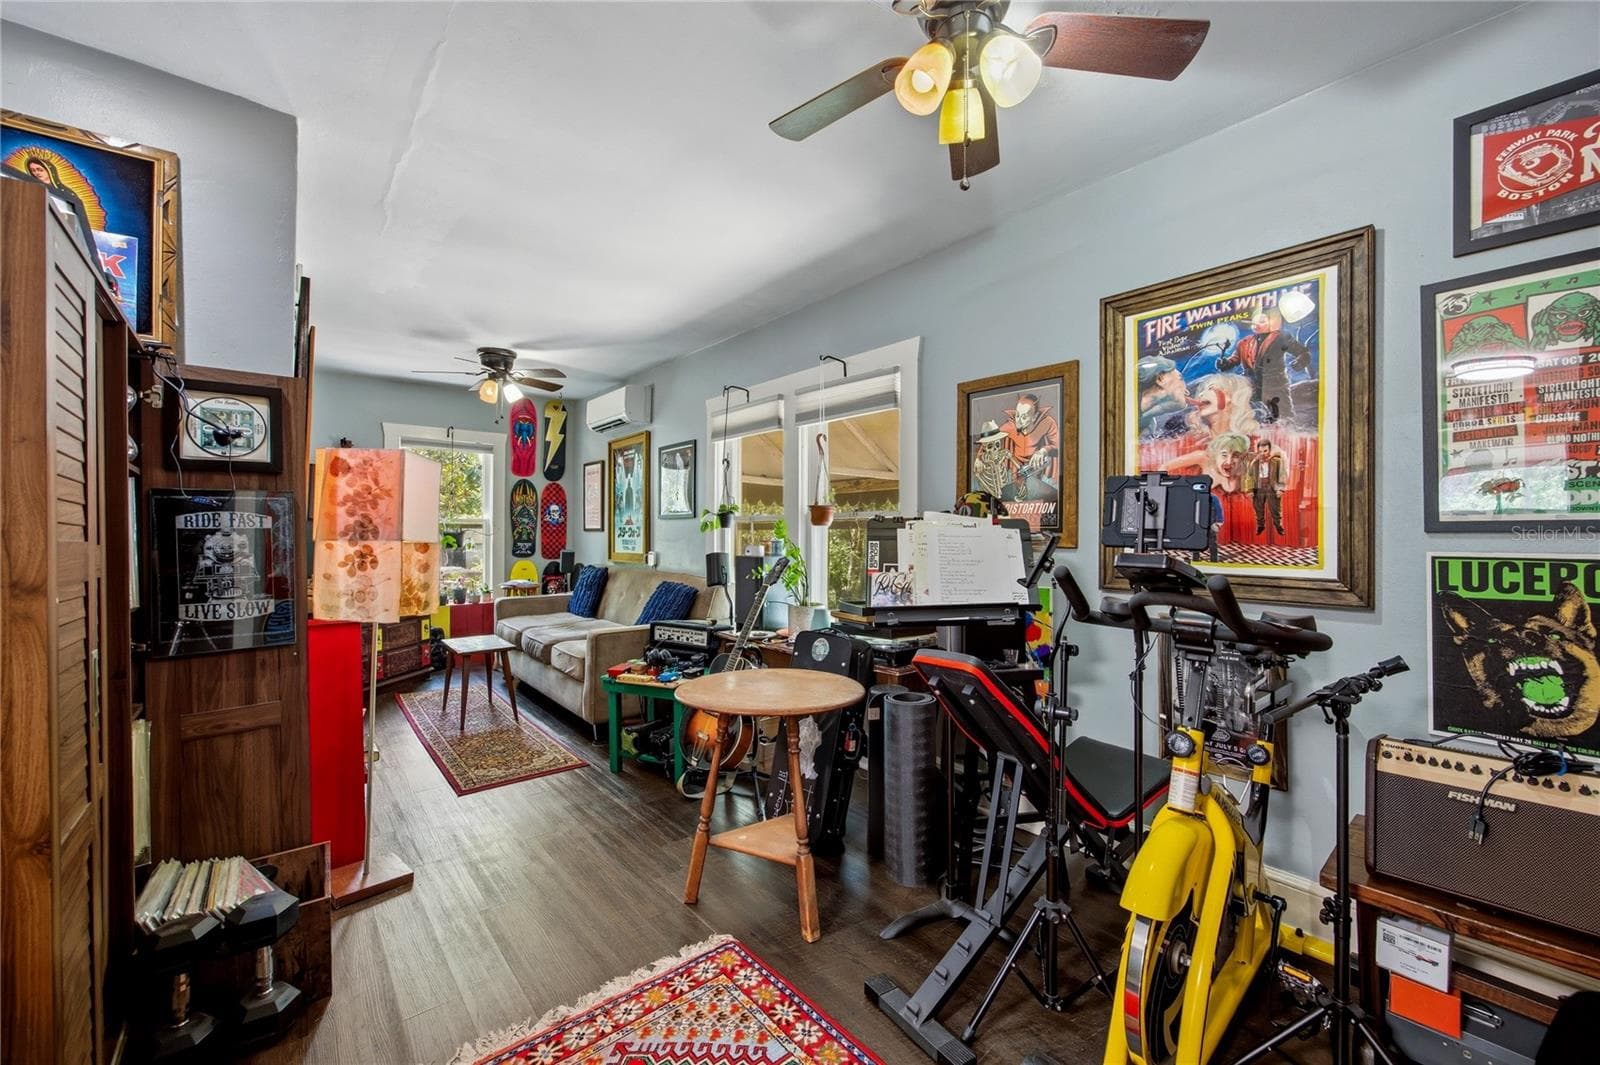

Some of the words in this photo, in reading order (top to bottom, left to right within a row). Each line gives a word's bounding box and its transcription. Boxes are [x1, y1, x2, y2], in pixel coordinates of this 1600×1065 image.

[1495, 130, 1541, 162] FENWAY
[1546, 129, 1578, 141] PARK
[1496, 172, 1574, 200] BOSTON
[1143, 312, 1183, 347] FIRE
[1186, 300, 1232, 327] WALK
[1234, 291, 1277, 313] WITH
[1189, 320, 1213, 332] TWIN
[1217, 311, 1249, 325] PEAKS
[1536, 358, 1561, 370] SAT
[1562, 355, 1583, 367] OCT
[1452, 381, 1513, 398] STREETLIGHT
[1459, 393, 1509, 409] MANIFESTO
[1535, 411, 1581, 424] CURSIVE
[184, 513, 221, 528] RIDE
[229, 512, 268, 528] FAST
[184, 603, 221, 619] LIVE
[226, 600, 270, 619] SLOW
[1215, 742, 1232, 750] JULY
